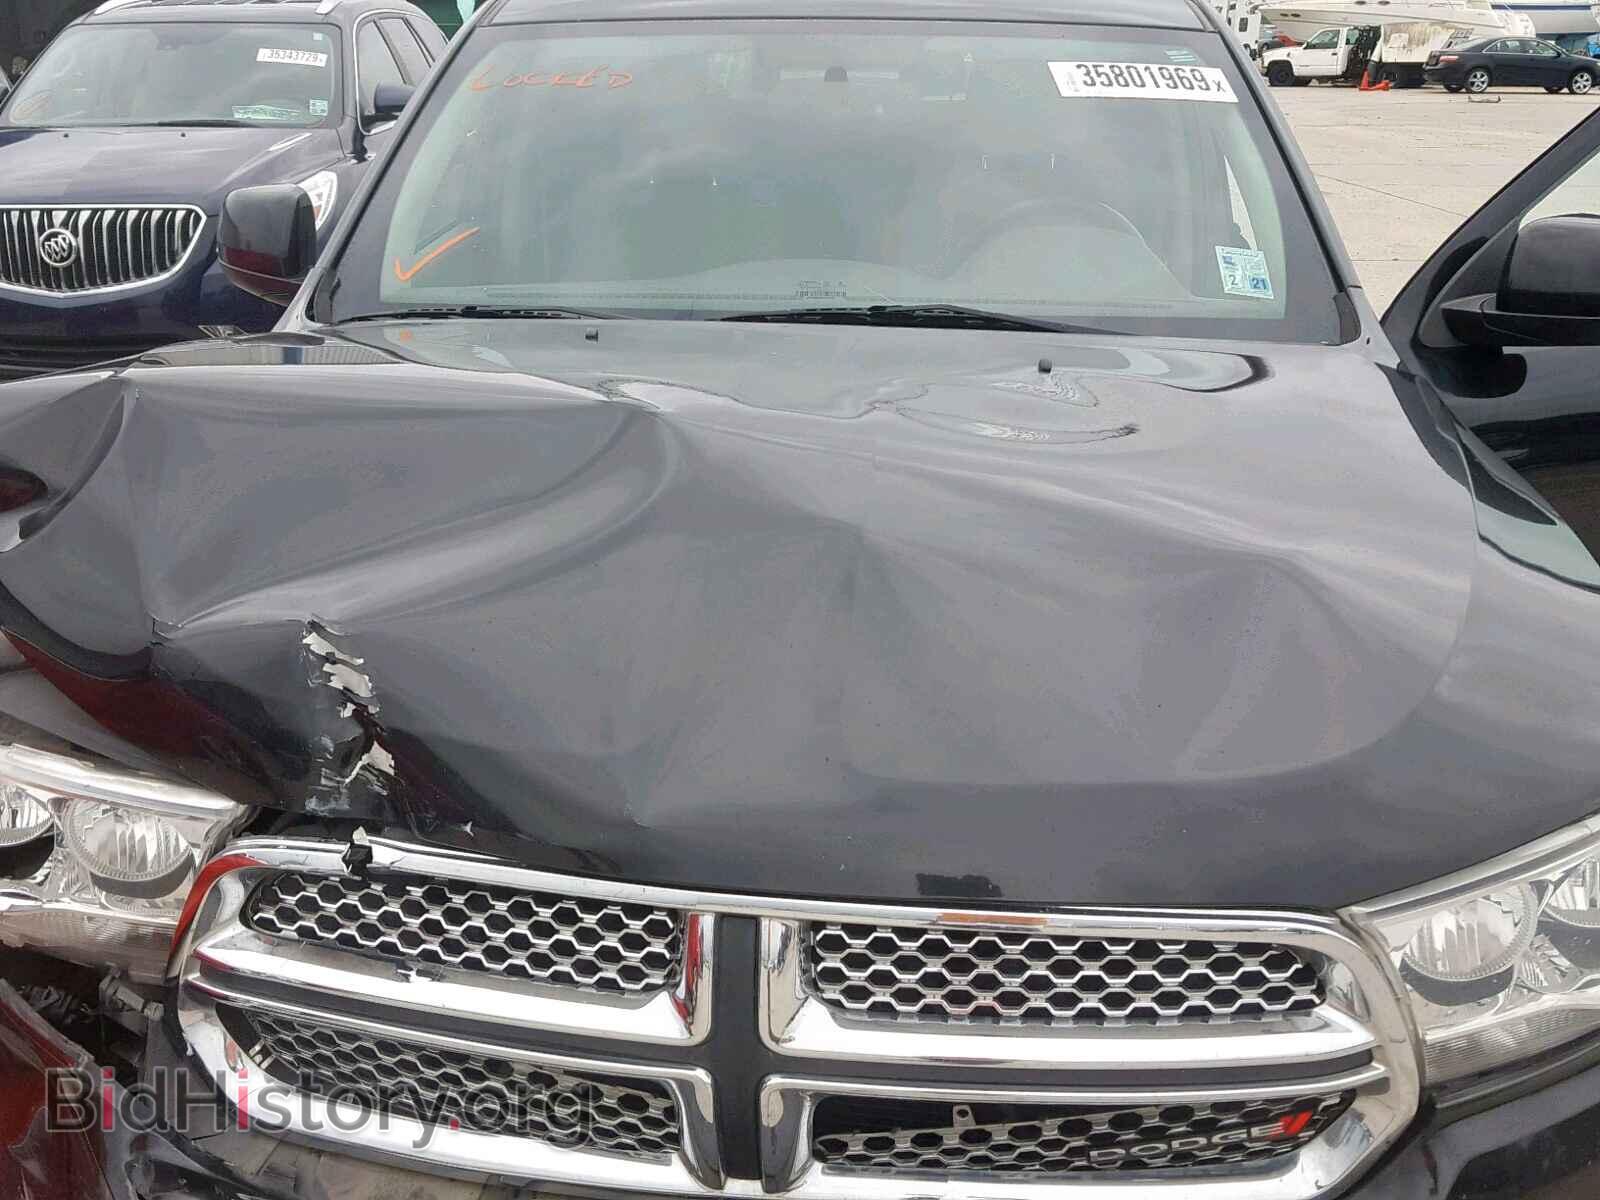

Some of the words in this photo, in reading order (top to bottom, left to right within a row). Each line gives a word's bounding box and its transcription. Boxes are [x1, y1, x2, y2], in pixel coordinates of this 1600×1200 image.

[1076, 63, 1211, 91] 35801969
[1228, 274, 1239, 286] 2
[1251, 277, 1267, 290] 21
[1089, 1122, 1285, 1162] DODGE
